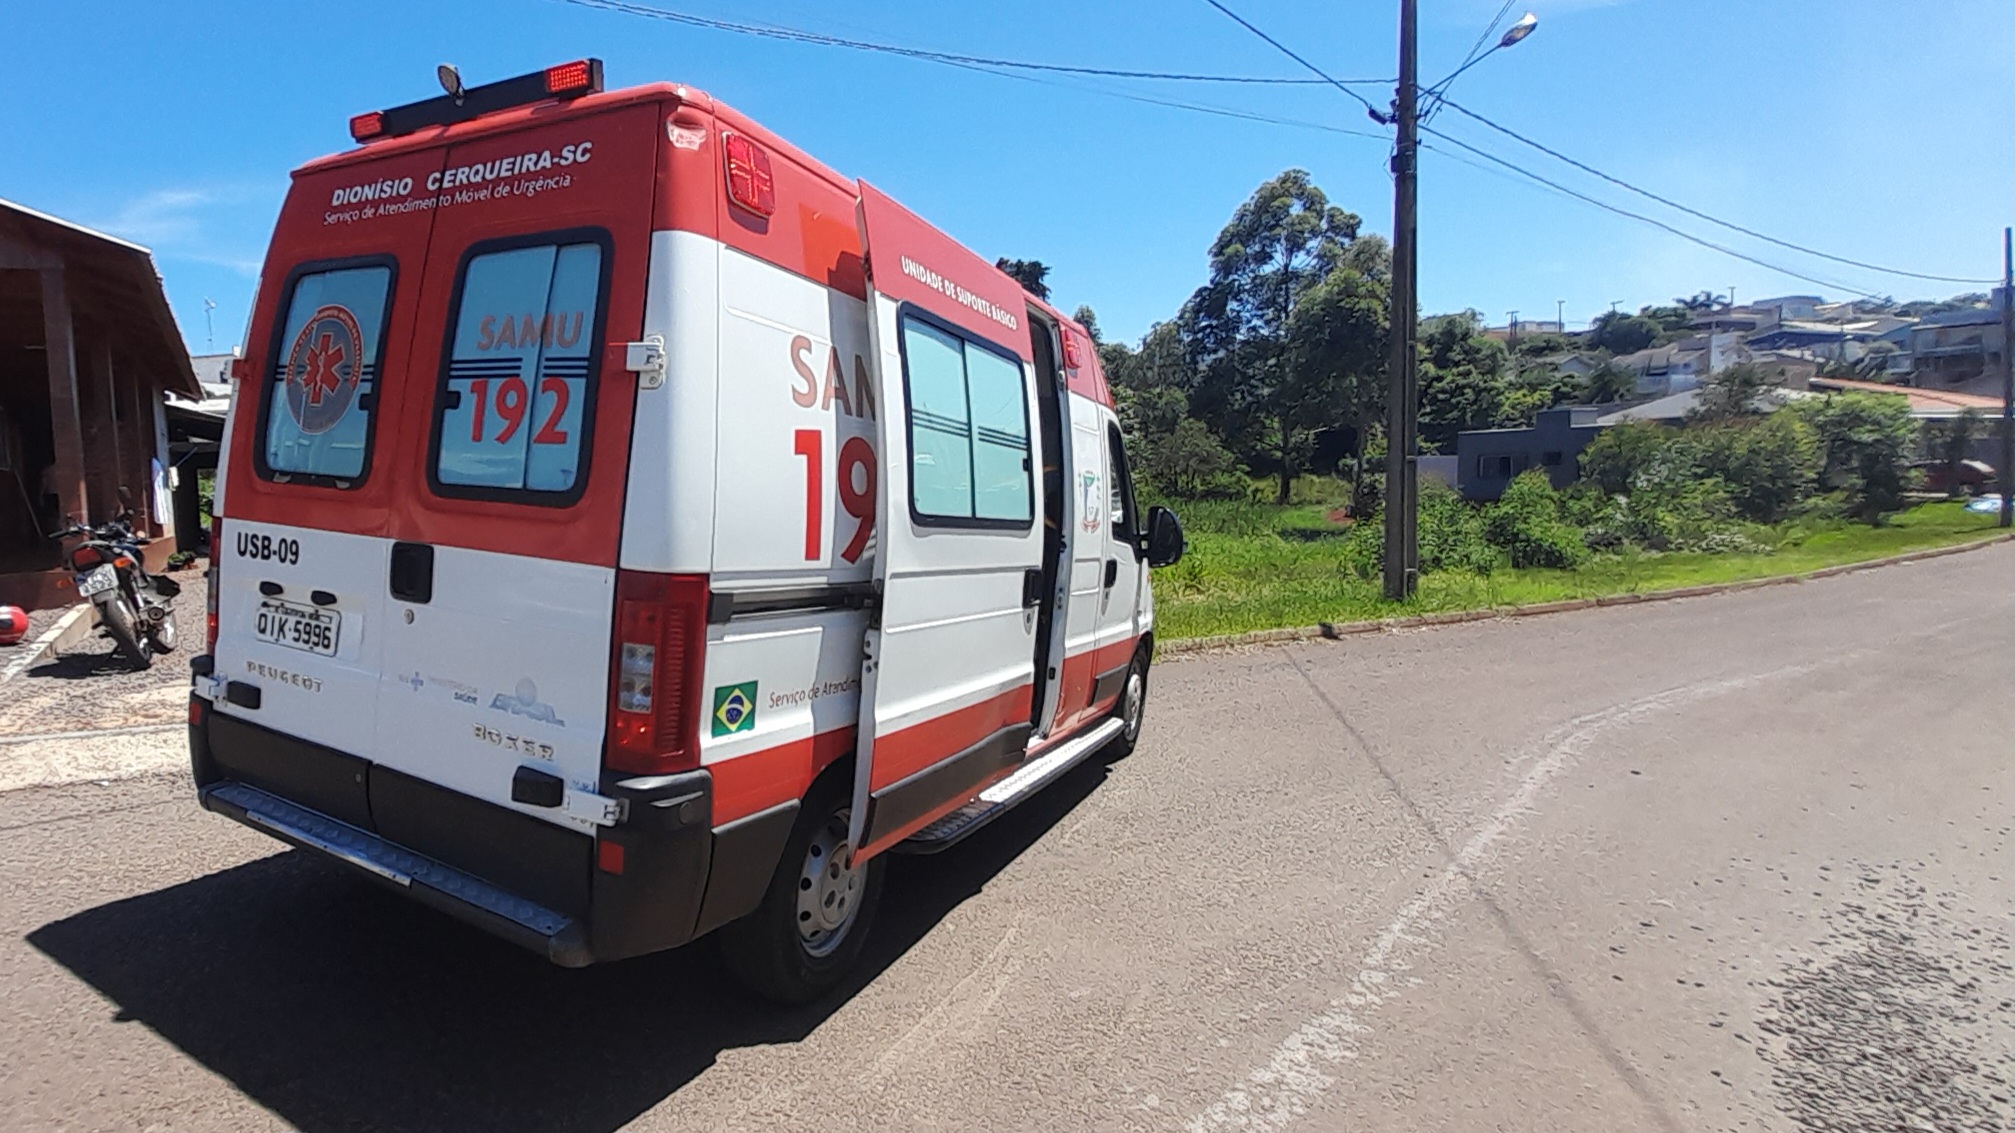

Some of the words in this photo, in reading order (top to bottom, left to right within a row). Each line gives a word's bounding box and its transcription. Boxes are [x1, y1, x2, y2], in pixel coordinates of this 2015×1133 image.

[331, 178, 413, 206] DIONÍSIO
[427, 141, 593, 191] CERQUEIRA-SC
[323, 209, 359, 225] Serviço
[361, 204, 375, 219] de
[376, 193, 451, 217] Atendimento
[453, 183, 492, 204] Móvel
[494, 181, 510, 198] de
[513, 172, 571, 197] Urgência
[901, 255, 944, 293] UNIDADE
[944, 279, 957, 299] DE
[956, 286, 991, 318] SUPORTE
[991, 303, 1018, 331] BÁSICO
[476, 311, 584, 351] SAMU
[470, 376, 569, 445] 192
[237, 531, 300, 565] USB-09
[246, 660, 324, 693] PEUGEOT
[768, 690, 806, 709] Serviço
[808, 685, 820, 700] de
[472, 722, 554, 762] BOXER
